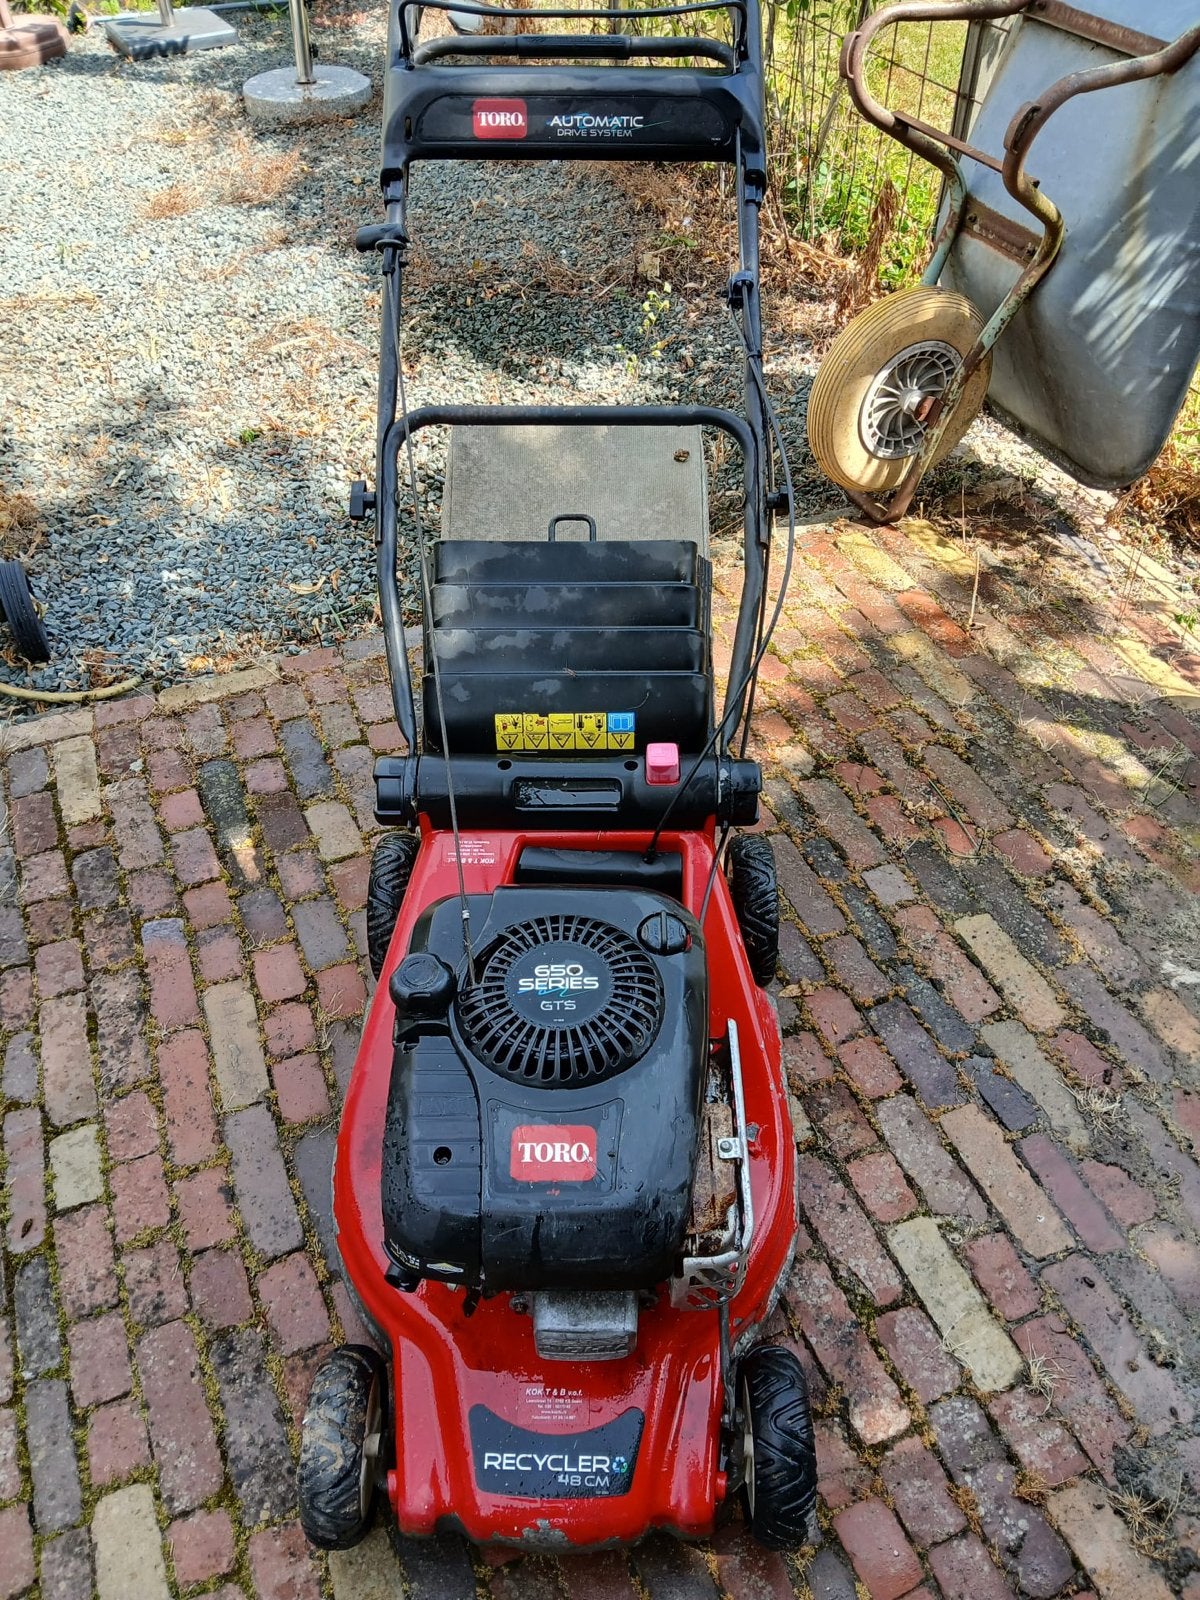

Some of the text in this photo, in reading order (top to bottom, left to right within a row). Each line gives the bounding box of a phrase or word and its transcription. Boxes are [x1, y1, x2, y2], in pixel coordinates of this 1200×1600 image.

[549, 116, 644, 128] AUTOMATIC
[557, 129, 633, 137] DRIVE SYSTEM
[534, 964, 584, 977] 650
[518, 977, 599, 990] SERIES
[540, 1000, 576, 1010] GTS
[545, 1388, 552, 1396] T
[552, 1388, 558, 1396] &
[560, 1388, 566, 1396] B
[483, 1452, 610, 1473] RECYCLER
[557, 1474, 610, 1487] 48 CM
